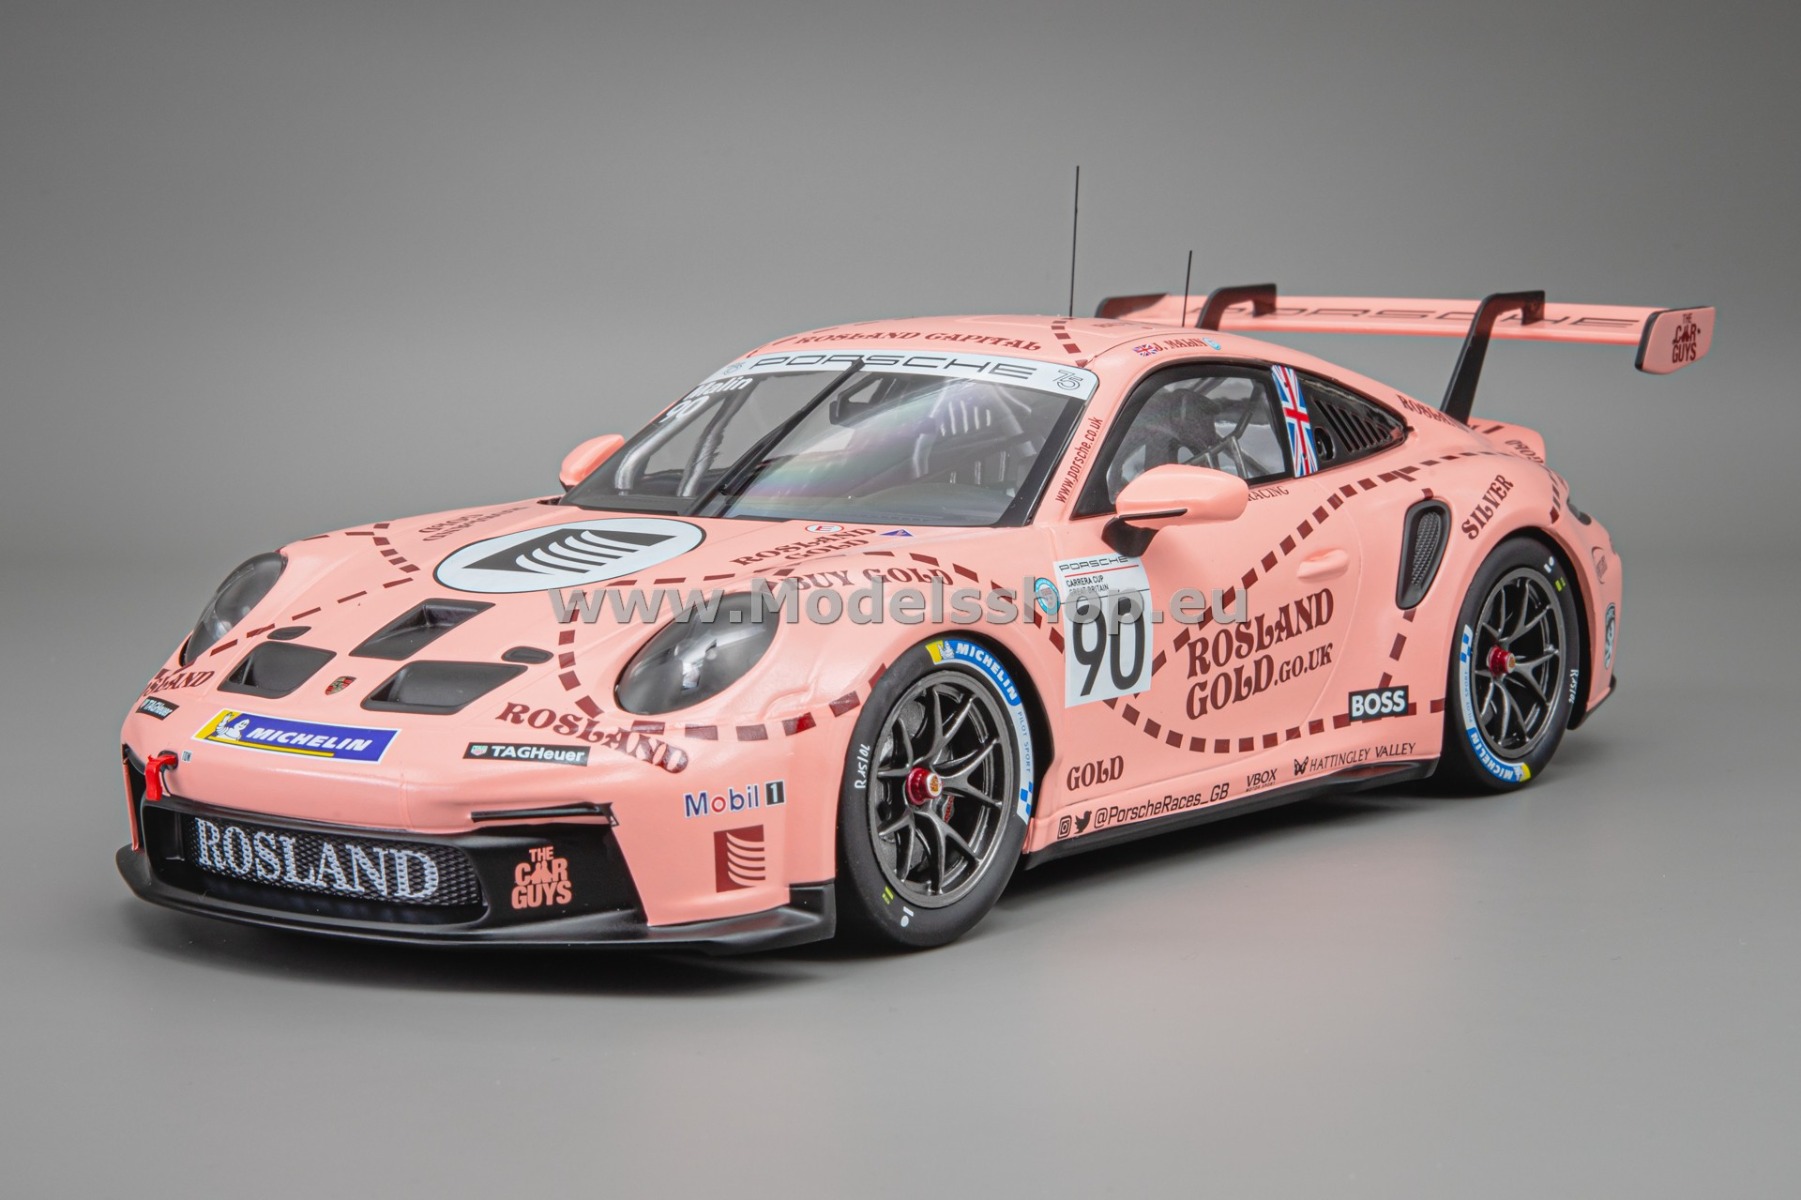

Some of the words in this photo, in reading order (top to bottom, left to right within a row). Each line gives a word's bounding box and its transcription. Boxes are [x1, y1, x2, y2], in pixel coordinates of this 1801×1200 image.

[796, 331, 921, 345] ROSLAND
[1672, 342, 1697, 363] GUYS
[748, 354, 1037, 380] PORSCHE
[1053, 369, 1084, 391] 75
[1055, 417, 1103, 503] www.porsche.co.uk
[1461, 474, 1514, 540] SILVER
[731, 528, 876, 566] ROSLAND
[784, 539, 869, 560] GOLD
[1058, 555, 1130, 572] PORSCHE
[793, 567, 855, 591] BUY
[862, 567, 954, 586] GOLD
[1065, 577, 1093, 588] CARRERA
[1093, 574, 1105, 585] CUP
[1072, 596, 1146, 697] 90
[1186, 588, 1335, 680] ROSLAND
[955, 641, 1018, 702] MICHELIN
[1351, 690, 1405, 718] BOSS
[246, 727, 374, 751] MICHELIN
[495, 701, 690, 774] ROSLAND
[490, 745, 586, 763] TAGHeuer
[1309, 748, 1371, 772] HATTINGLEY
[1374, 742, 1417, 759] VALLEY
[1470, 731, 1514, 781] MICHELIN
[1065, 755, 1125, 791] GOLD
[1246, 768, 1278, 787] VBOX
[684, 784, 760, 819] Mobil
[1093, 782, 1230, 829] @PorscheRaces_GB
[194, 816, 440, 899] ROSLAND
[528, 846, 554, 862] THE
[511, 881, 573, 910] GUYS
